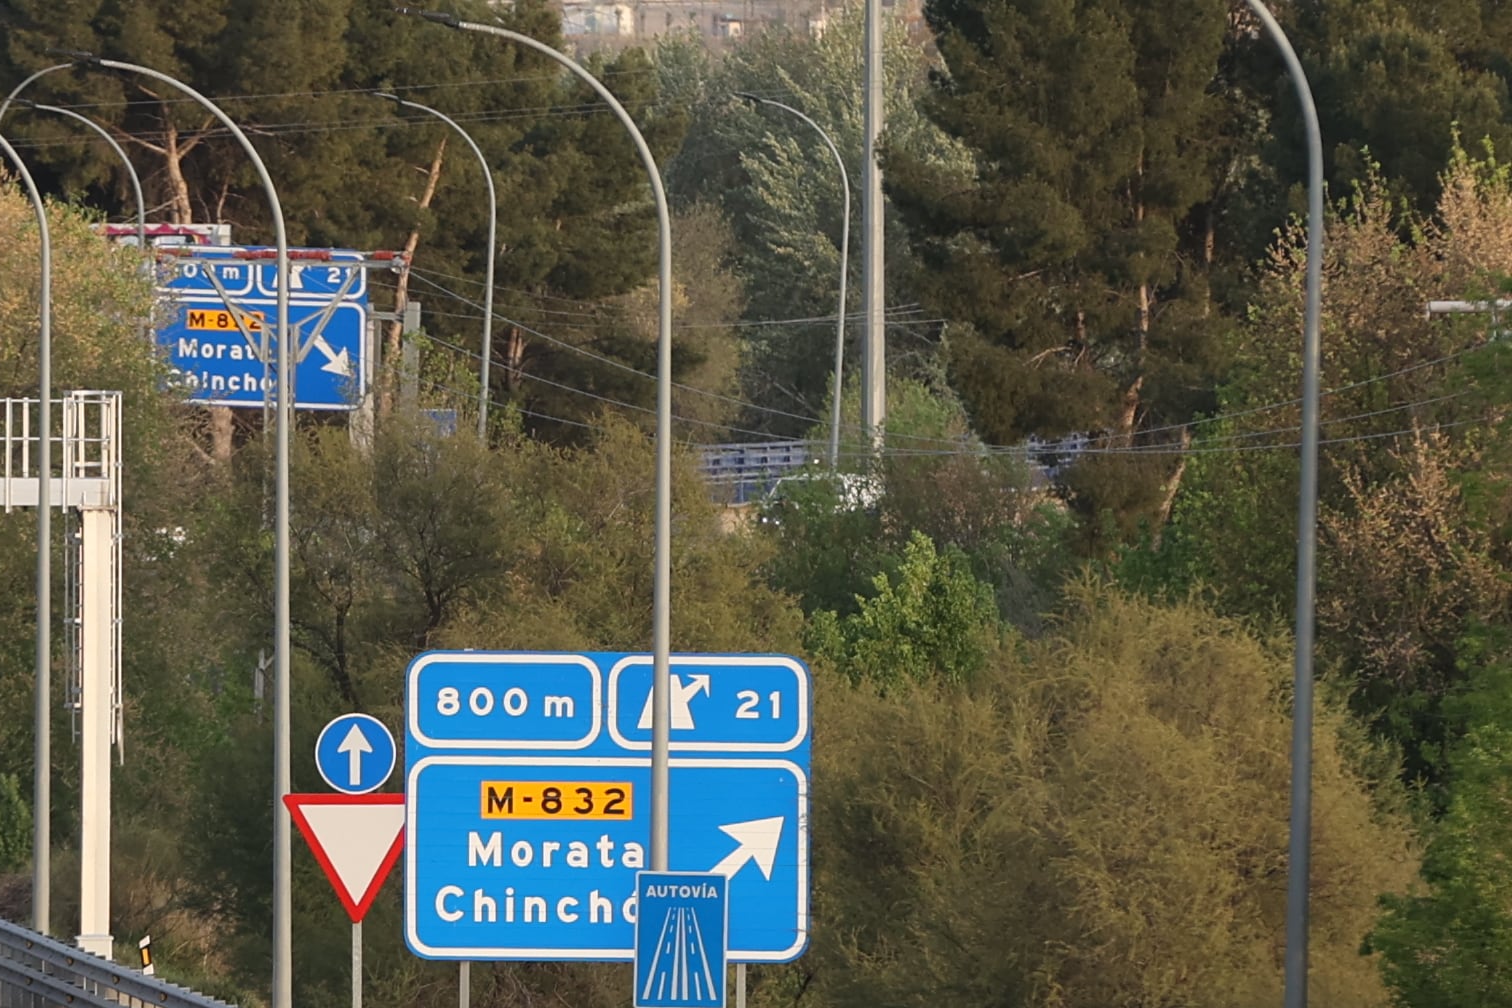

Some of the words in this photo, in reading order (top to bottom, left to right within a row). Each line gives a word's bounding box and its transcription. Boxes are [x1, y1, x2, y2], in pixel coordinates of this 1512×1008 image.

[223, 266, 239, 280] m
[179, 338, 272, 360] Morat
[436, 687, 528, 717] 800
[544, 695, 574, 718] m
[734, 691, 782, 719] 21
[487, 786, 626, 815] M-832
[468, 832, 645, 868] Morata
[646, 884, 718, 899] AUTOVÍA
